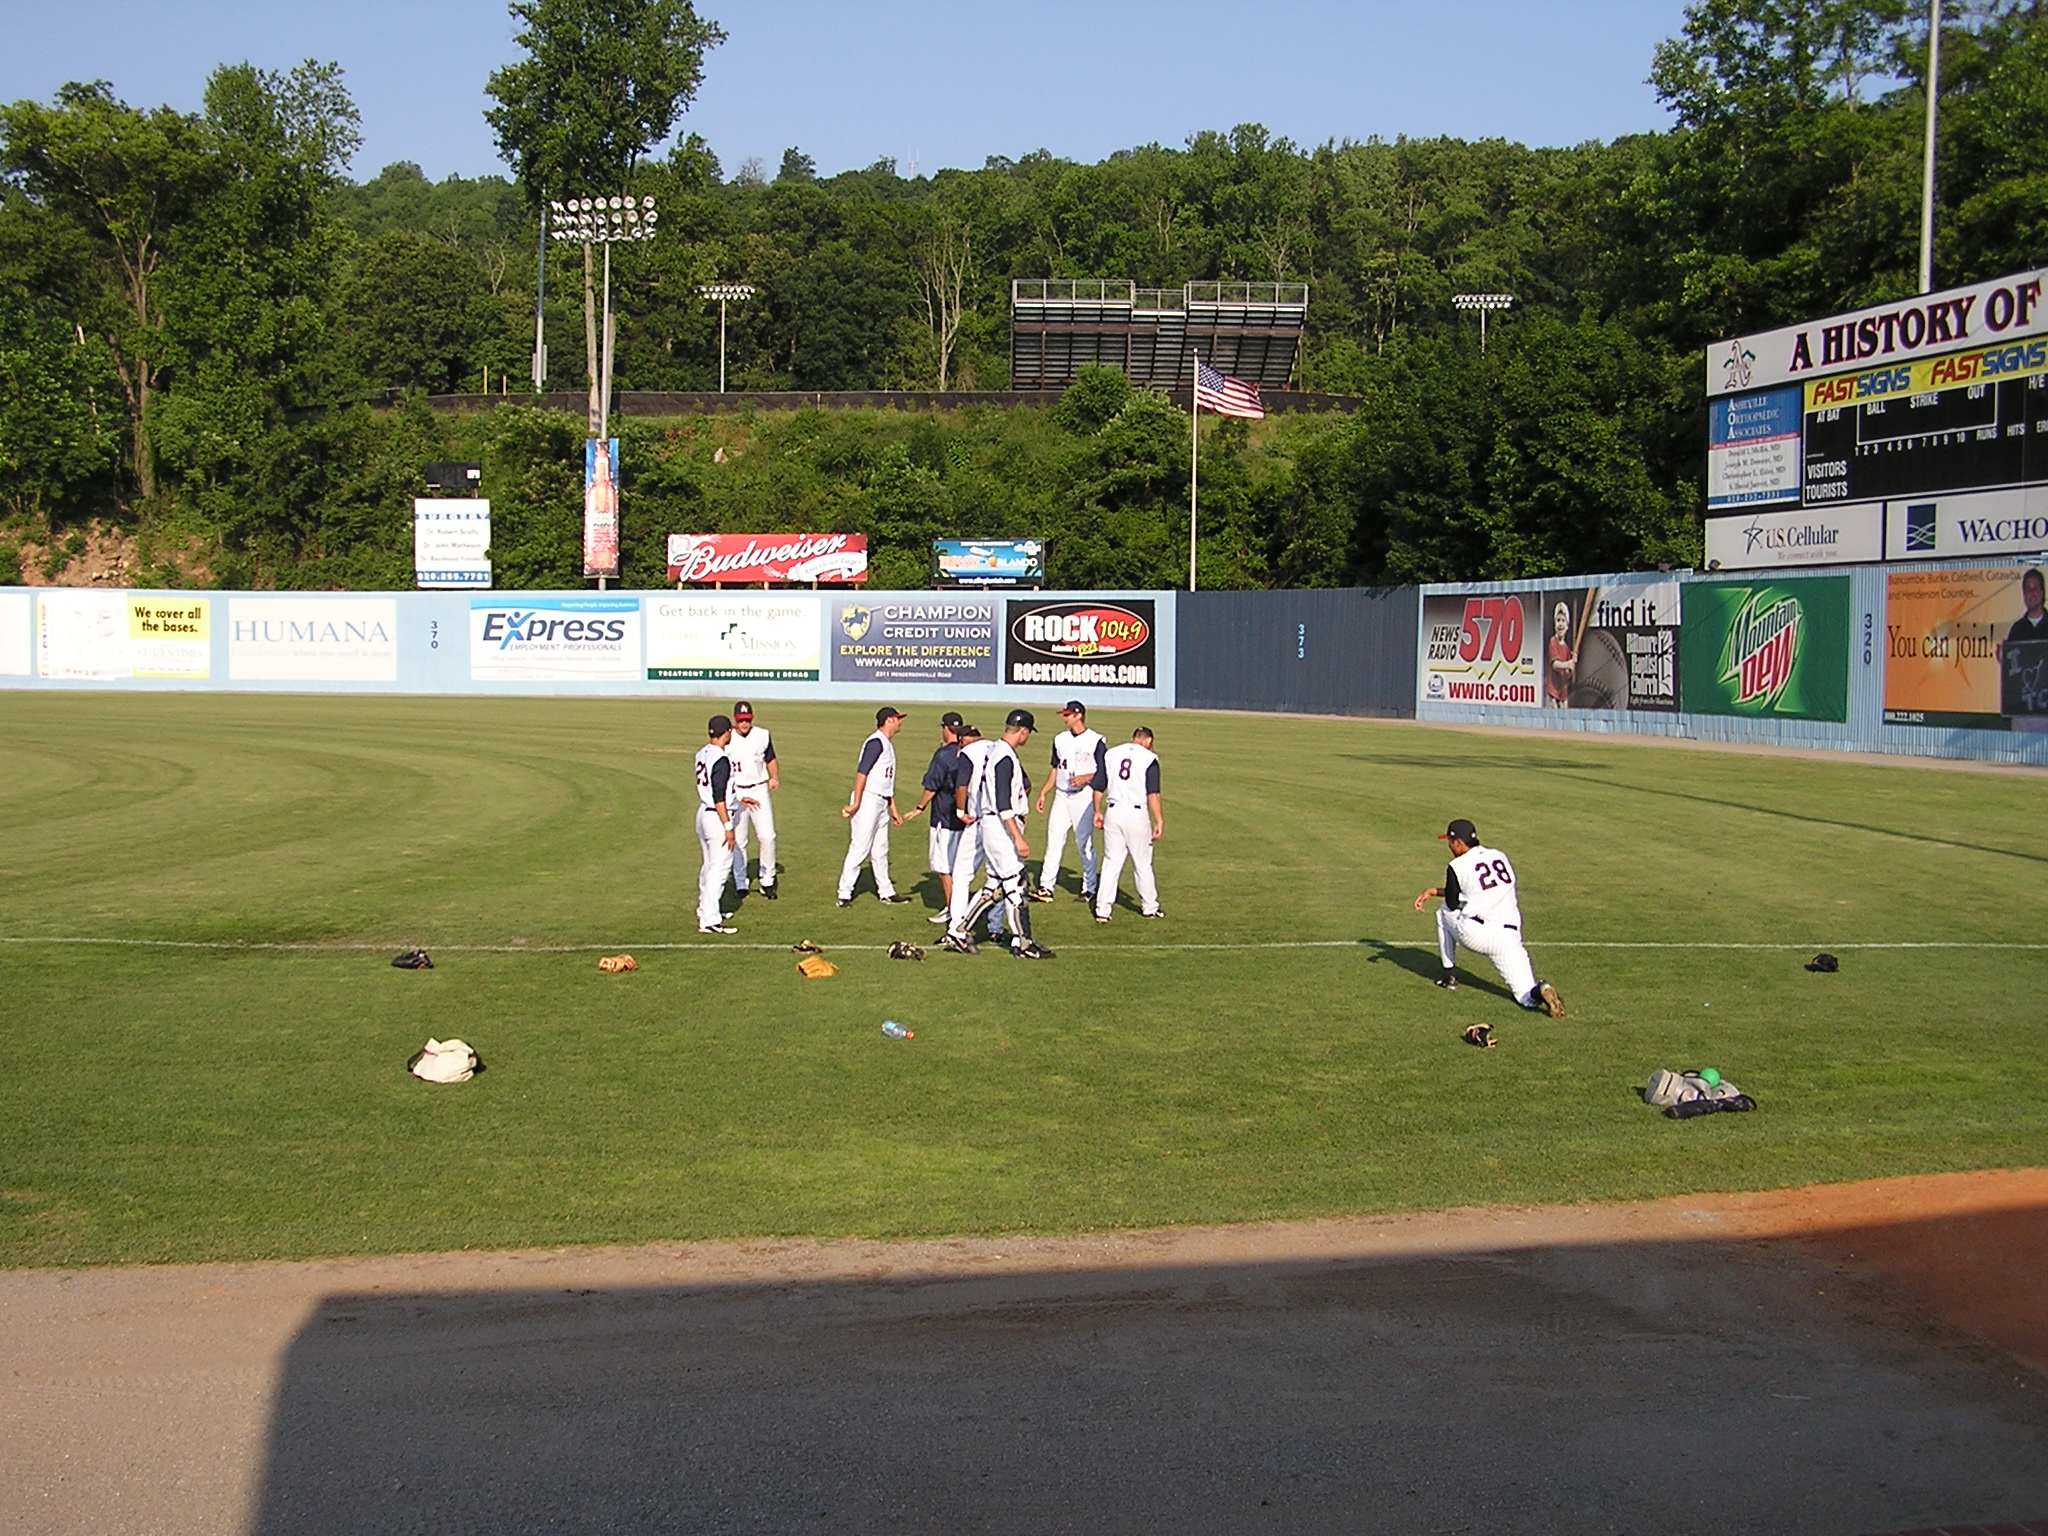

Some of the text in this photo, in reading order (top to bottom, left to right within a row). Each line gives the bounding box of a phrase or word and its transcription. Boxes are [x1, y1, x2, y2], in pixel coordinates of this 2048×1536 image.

[1789, 278, 2043, 373] A HISTORY OF
[1930, 340, 2047, 387] FASTSIGNS
[1813, 366, 1912, 406] FASTSIGNS
[1967, 385, 1986, 400] OUT
[1866, 402, 1886, 416] BALL
[1910, 392, 1938, 409] STRIKE
[1816, 408, 1840, 423] AT BAT
[1855, 447, 1859, 456] 1
[1863, 445, 1868, 455] 2
[1873, 443, 1878, 454] 3
[1887, 442, 1892, 451] 4
[1897, 440, 1902, 451] 5
[1907, 439, 1913, 450] 6
[1922, 437, 1927, 447] 7
[1932, 435, 1937, 446] 8
[1943, 434, 1948, 445] 9
[1956, 432, 1965, 443] 10
[1976, 427, 1997, 440] RUNS
[2007, 423, 2025, 437] HITS
[1807, 460, 1847, 479] VISITORS
[1805, 481, 1848, 500] TOURISTS
[1786, 525, 1839, 548] Cellular
[680, 533, 848, 582] Budweiser
[135, 606, 202, 619] We cover all
[659, 605, 806, 621] Get back in the game.
[884, 605, 992, 620] CHAMPION
[1597, 599, 1657, 627] find it
[142, 619, 198, 633] the bases.
[234, 620, 389, 642] HUMANA
[482, 612, 626, 651] Express
[883, 627, 992, 639] CREDIT UNION
[1025, 615, 1143, 642] ROCK 104.9
[1431, 625, 1460, 642] NEWS
[1459, 595, 1525, 663] 570
[1732, 600, 1796, 668] Mountain
[510, 643, 622, 651] EMPLOYMENT PROFESSIONALS
[840, 645, 991, 657] EXPLORE THE DIFFERENCE
[1428, 643, 1458, 660] RADIO
[1888, 623, 1994, 669] You can join!
[855, 658, 977, 669] WWW.CHAMPIONCU.COM
[1013, 662, 1148, 685] ROCK104ROCKS.COM
[1448, 682, 1535, 703] wwnc.com
[1118, 758, 1132, 780] 8
[1475, 859, 1512, 891] 28
